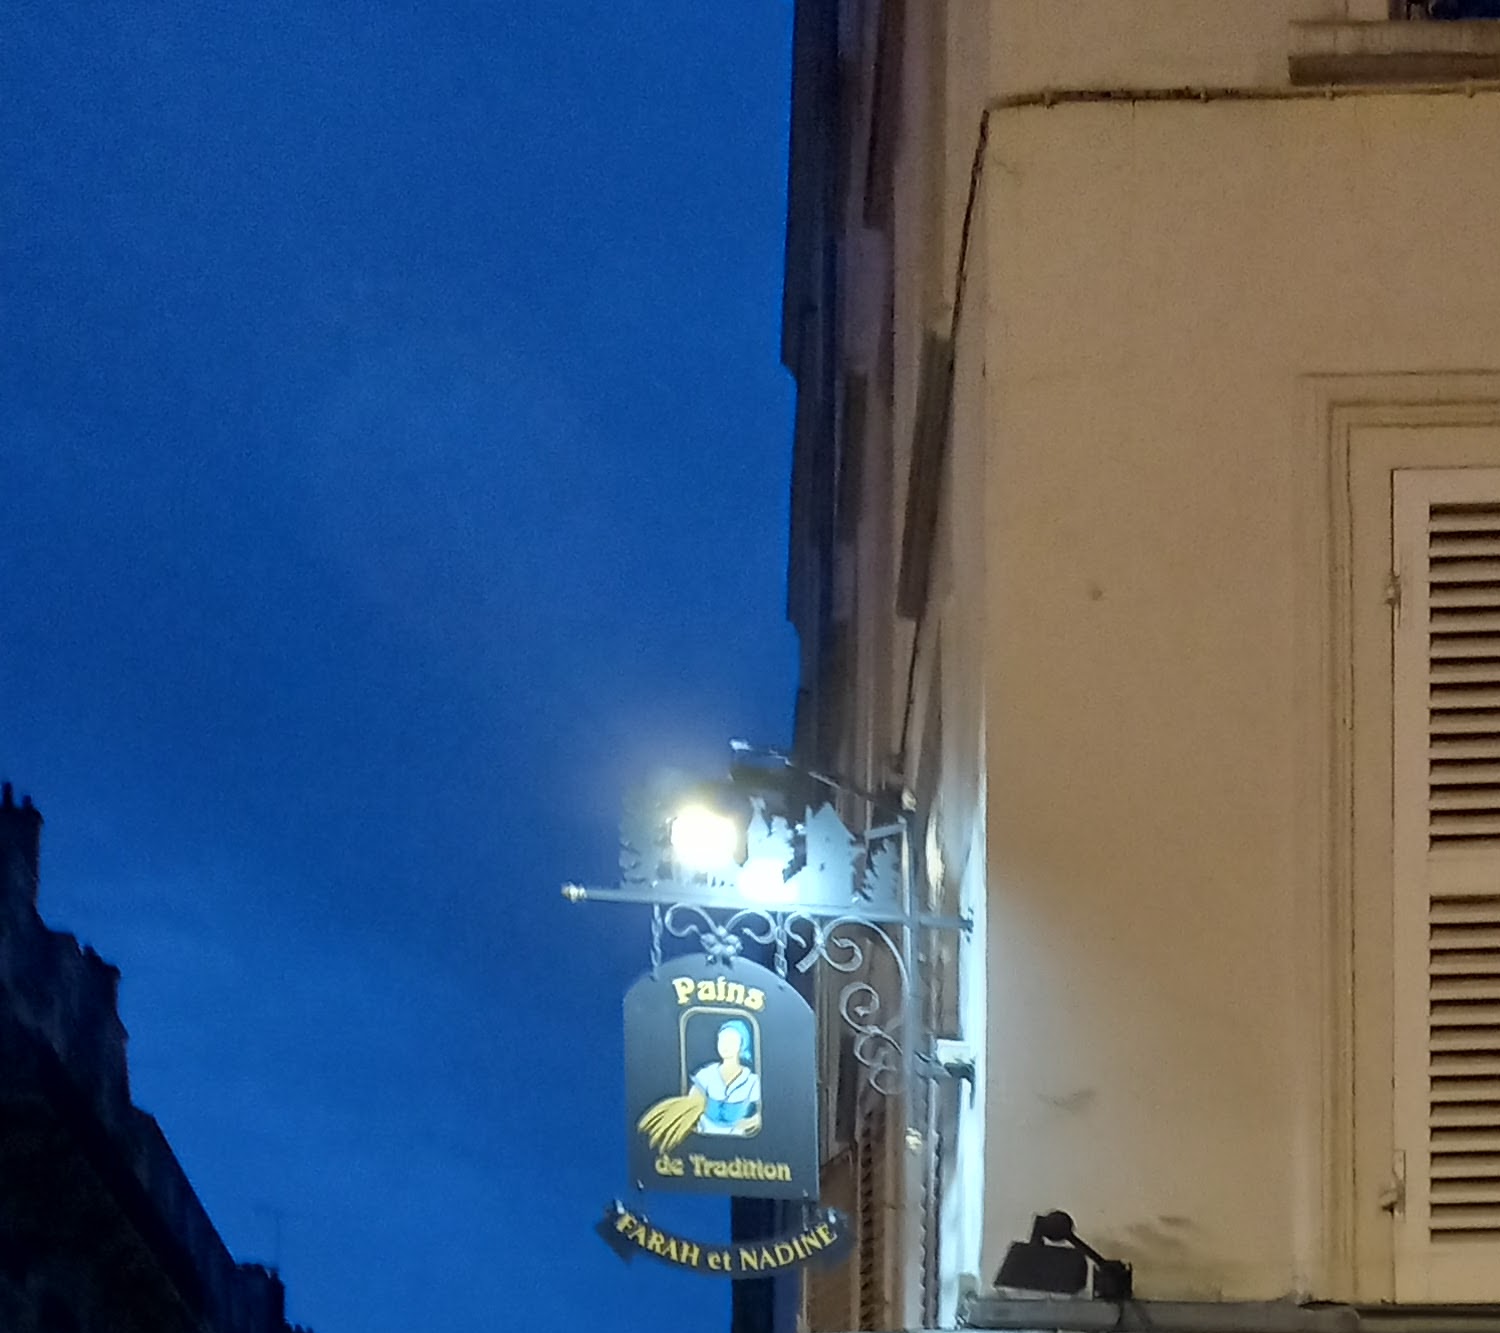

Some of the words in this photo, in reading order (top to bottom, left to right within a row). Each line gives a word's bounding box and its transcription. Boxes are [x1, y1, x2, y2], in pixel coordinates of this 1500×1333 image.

[671, 976, 766, 1011] Pains
[655, 1153, 684, 1176] de
[688, 1154, 793, 1182] Tradition
[615, 1212, 700, 1268] FARAH
[707, 1250, 732, 1271] et
[740, 1223, 838, 1272] NADINE
